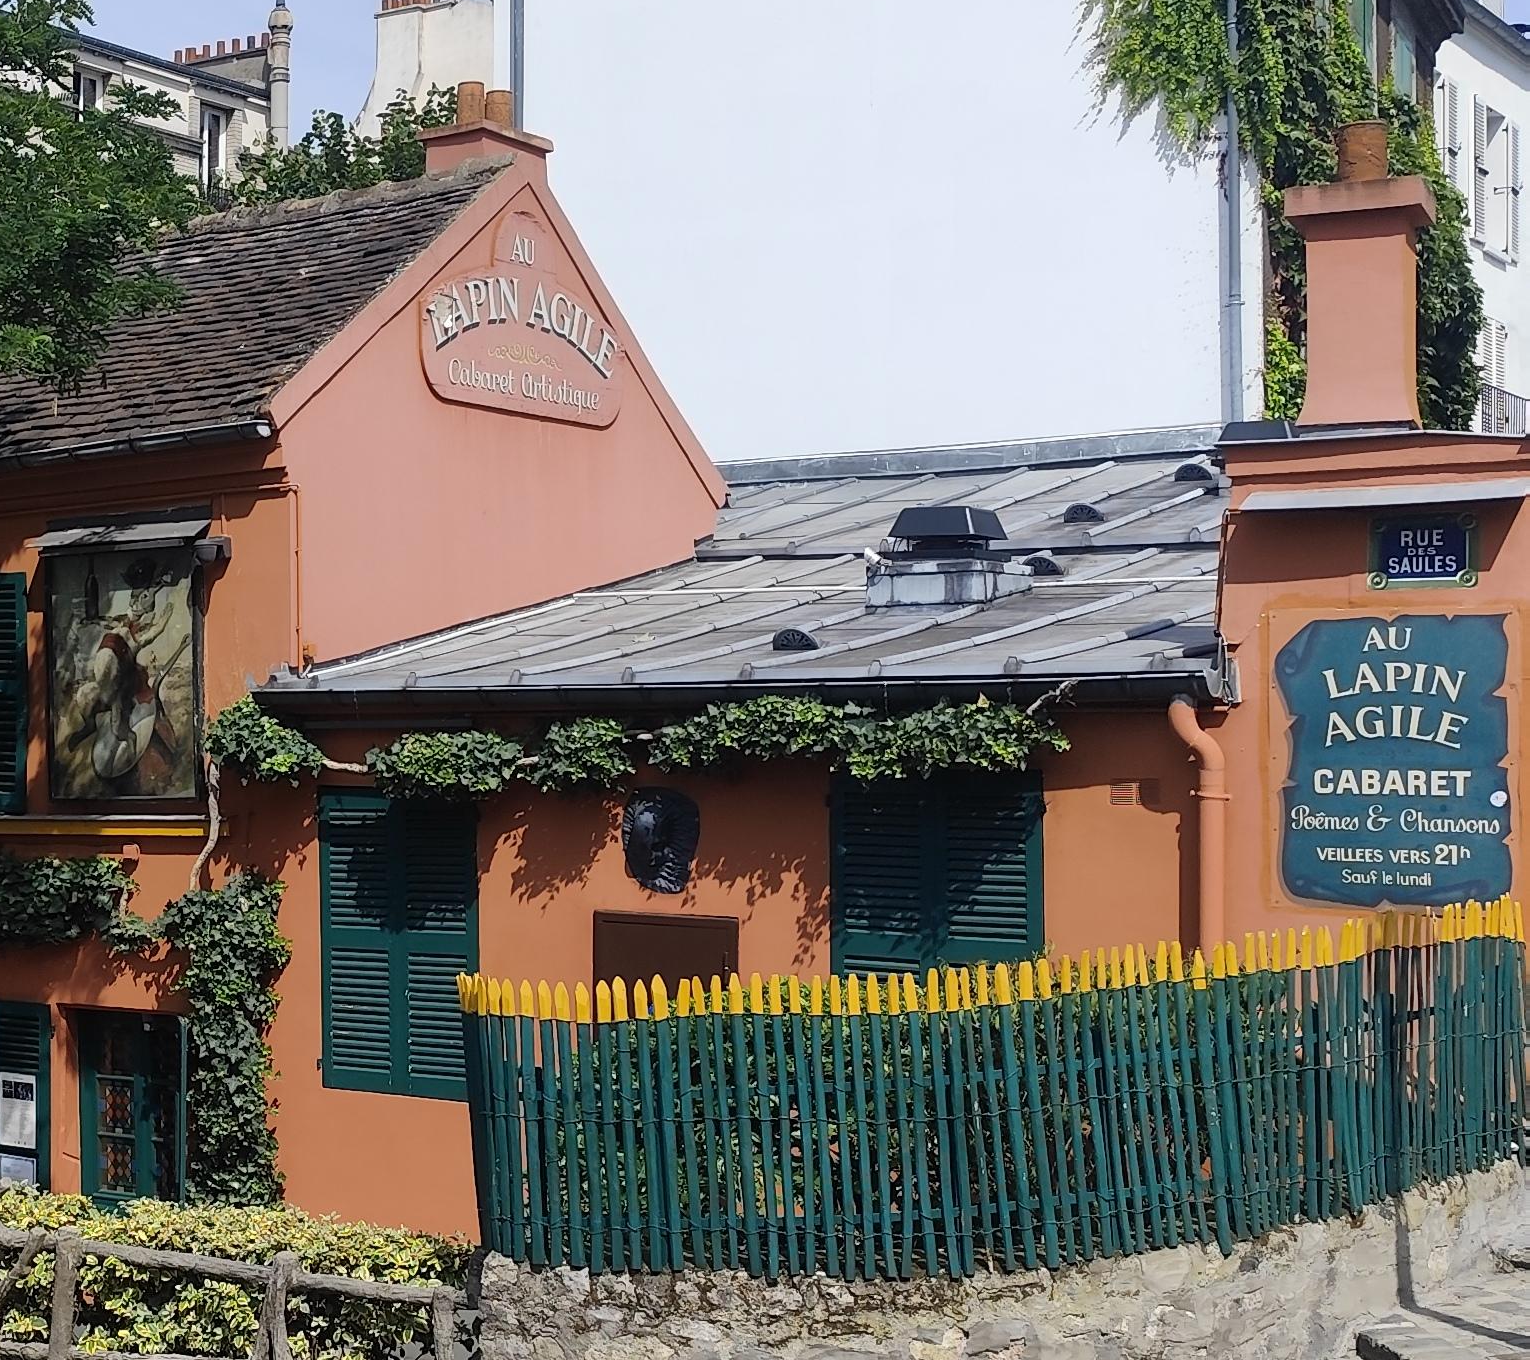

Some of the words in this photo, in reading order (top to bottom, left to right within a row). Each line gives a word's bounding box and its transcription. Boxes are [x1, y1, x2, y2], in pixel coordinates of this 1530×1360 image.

[510, 232, 535, 265] AU
[426, 276, 520, 351] LAPIN
[526, 281, 619, 380] AGILE
[448, 358, 515, 394] Cabaret
[1400, 529, 1444, 547] RUE
[1407, 547, 1437, 556] DES
[1388, 555, 1457, 574] SAULES
[1362, 626, 1412, 652] AU
[1322, 662, 1467, 704] LAPIN
[1324, 705, 1470, 750] AGILE
[1313, 768, 1471, 797] CABARET
[1366, 804, 1393, 832] &
[1400, 808, 1501, 834] Chansons
[1316, 847, 1384, 863] VEILLEES
[1389, 849, 1431, 865] VERS
[1341, 869, 1378, 885] Sauf
[1382, 871, 1393, 885] le
[1396, 871, 1432, 887] lundi
